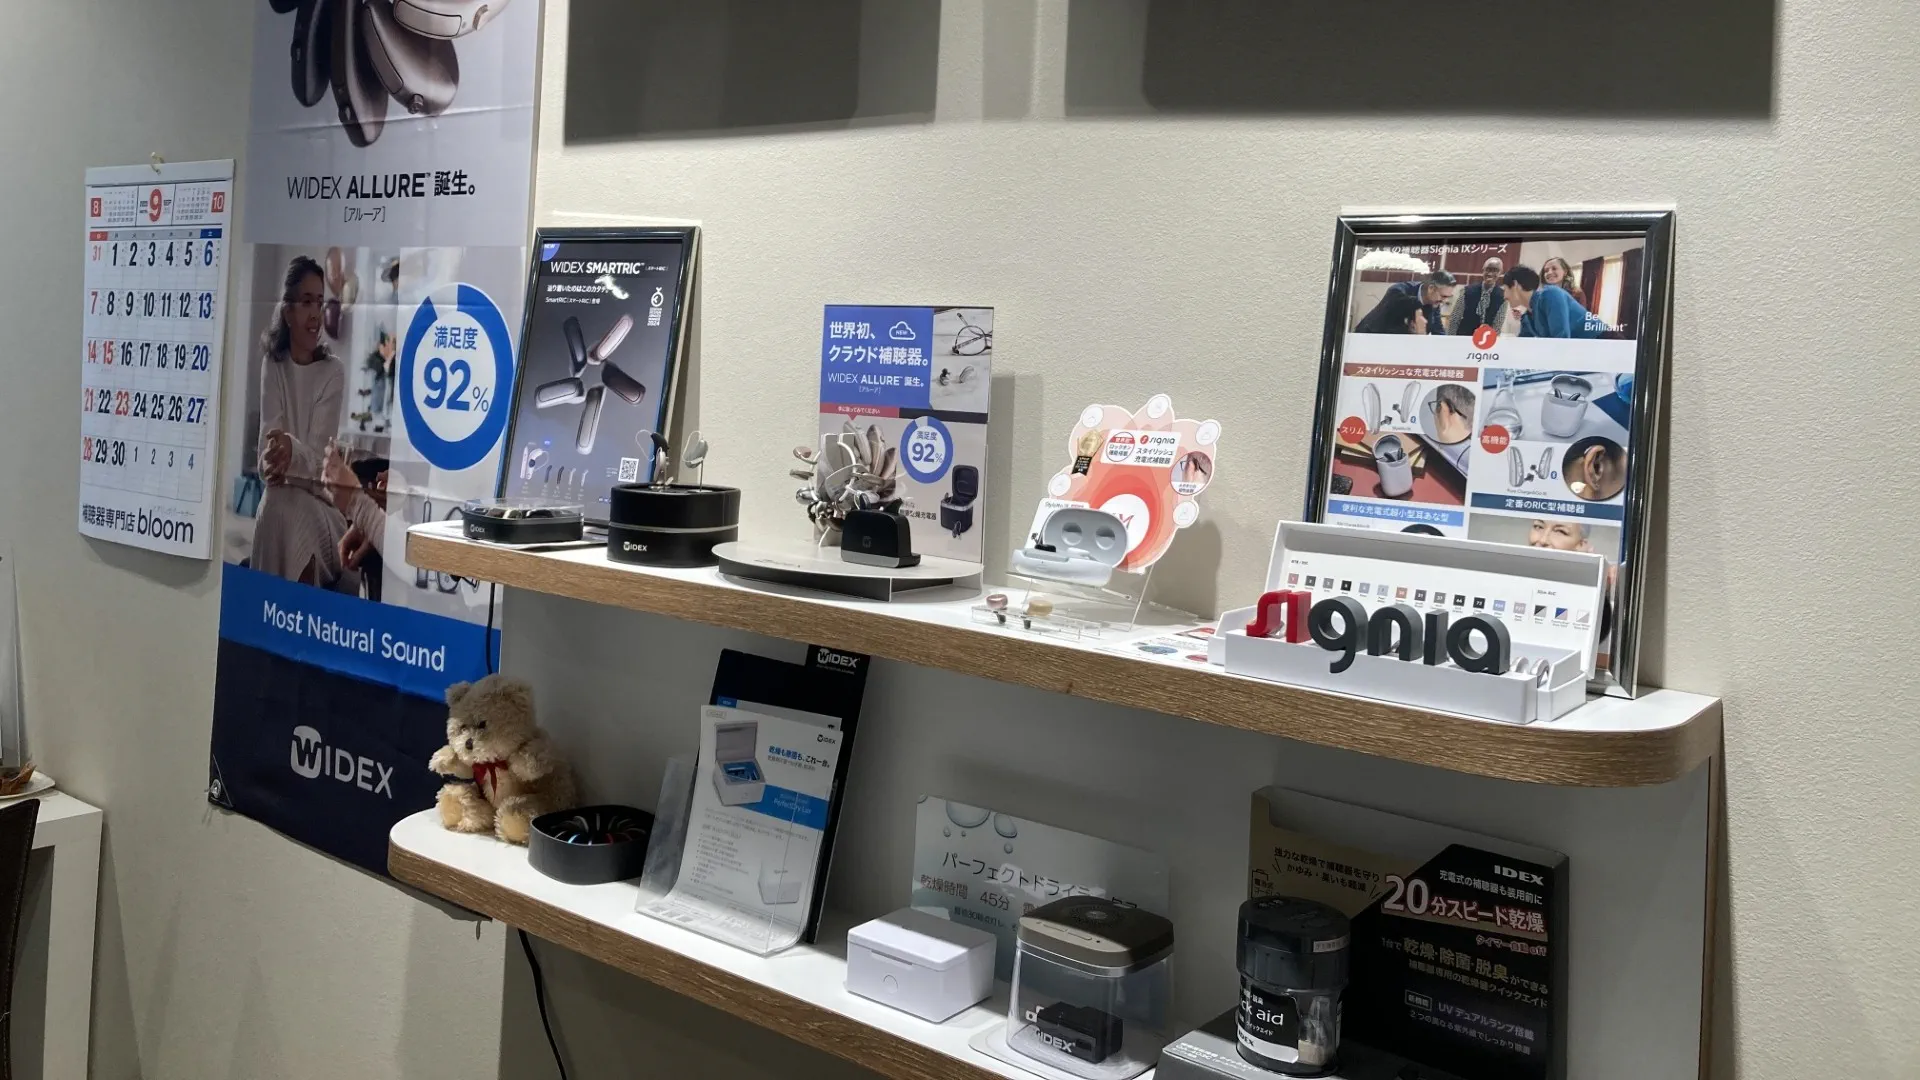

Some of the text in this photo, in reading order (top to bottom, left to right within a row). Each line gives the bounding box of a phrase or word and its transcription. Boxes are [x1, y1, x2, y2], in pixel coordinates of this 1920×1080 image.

[287, 176, 342, 199] WIDEX
[434, 170, 475, 196] 誕生。
[93, 200, 99, 215] 8
[149, 188, 162, 222] 9
[213, 195, 223, 210] 10
[92, 240, 214, 267] 31 1 2 3 4 5 6
[550, 261, 585, 273] WIDEX
[91, 291, 212, 319] 7 8 9 10 11 12 13
[1585, 311, 1599, 321] Be
[433, 325, 478, 350] 満足度
[829, 322, 876, 340] 世界初、
[88, 340, 209, 371] 14 15 16 17 18 19 20
[828, 344, 928, 366] クラウド補聴器。
[1465, 352, 1499, 362] signia
[827, 372, 859, 383] WIDEX
[1356, 366, 1464, 379] スタイリッシュな充電式補聴器
[423, 357, 489, 412] 92%
[84, 388, 205, 424] 21 22 23 24 25 26 27
[916, 431, 938, 440] 満足度
[1341, 425, 1364, 435] スリム
[1481, 433, 1509, 446] 高機能
[1149, 437, 1176, 446] signia
[83, 437, 92, 461] 28
[95, 438, 108, 464] 29
[112, 441, 125, 466] 30
[151, 448, 156, 465] 2
[168, 451, 174, 467] 3
[188, 453, 194, 469] 4
[1505, 498, 1585, 514] 定番のRIC型補聴器
[82, 503, 194, 544] 補聴器専門店 bloom
[623, 541, 647, 552] WIDEX
[263, 600, 445, 672] Most Natural Sound
[1246, 589, 1511, 674] signia
[817, 648, 857, 668] WIDEX
[817, 734, 836, 744] WIDEX
[291, 725, 394, 800] WIDEX
[1493, 865, 1544, 886] IDEX
[920, 874, 968, 899] 乾燥時間
[980, 891, 1009, 911] 45分
[1439, 869, 1543, 905] 充電式の補聴器も装用前に
[1384, 875, 1545, 933] 20分スピード乾燥
[1256, 1008, 1284, 1026] aid
